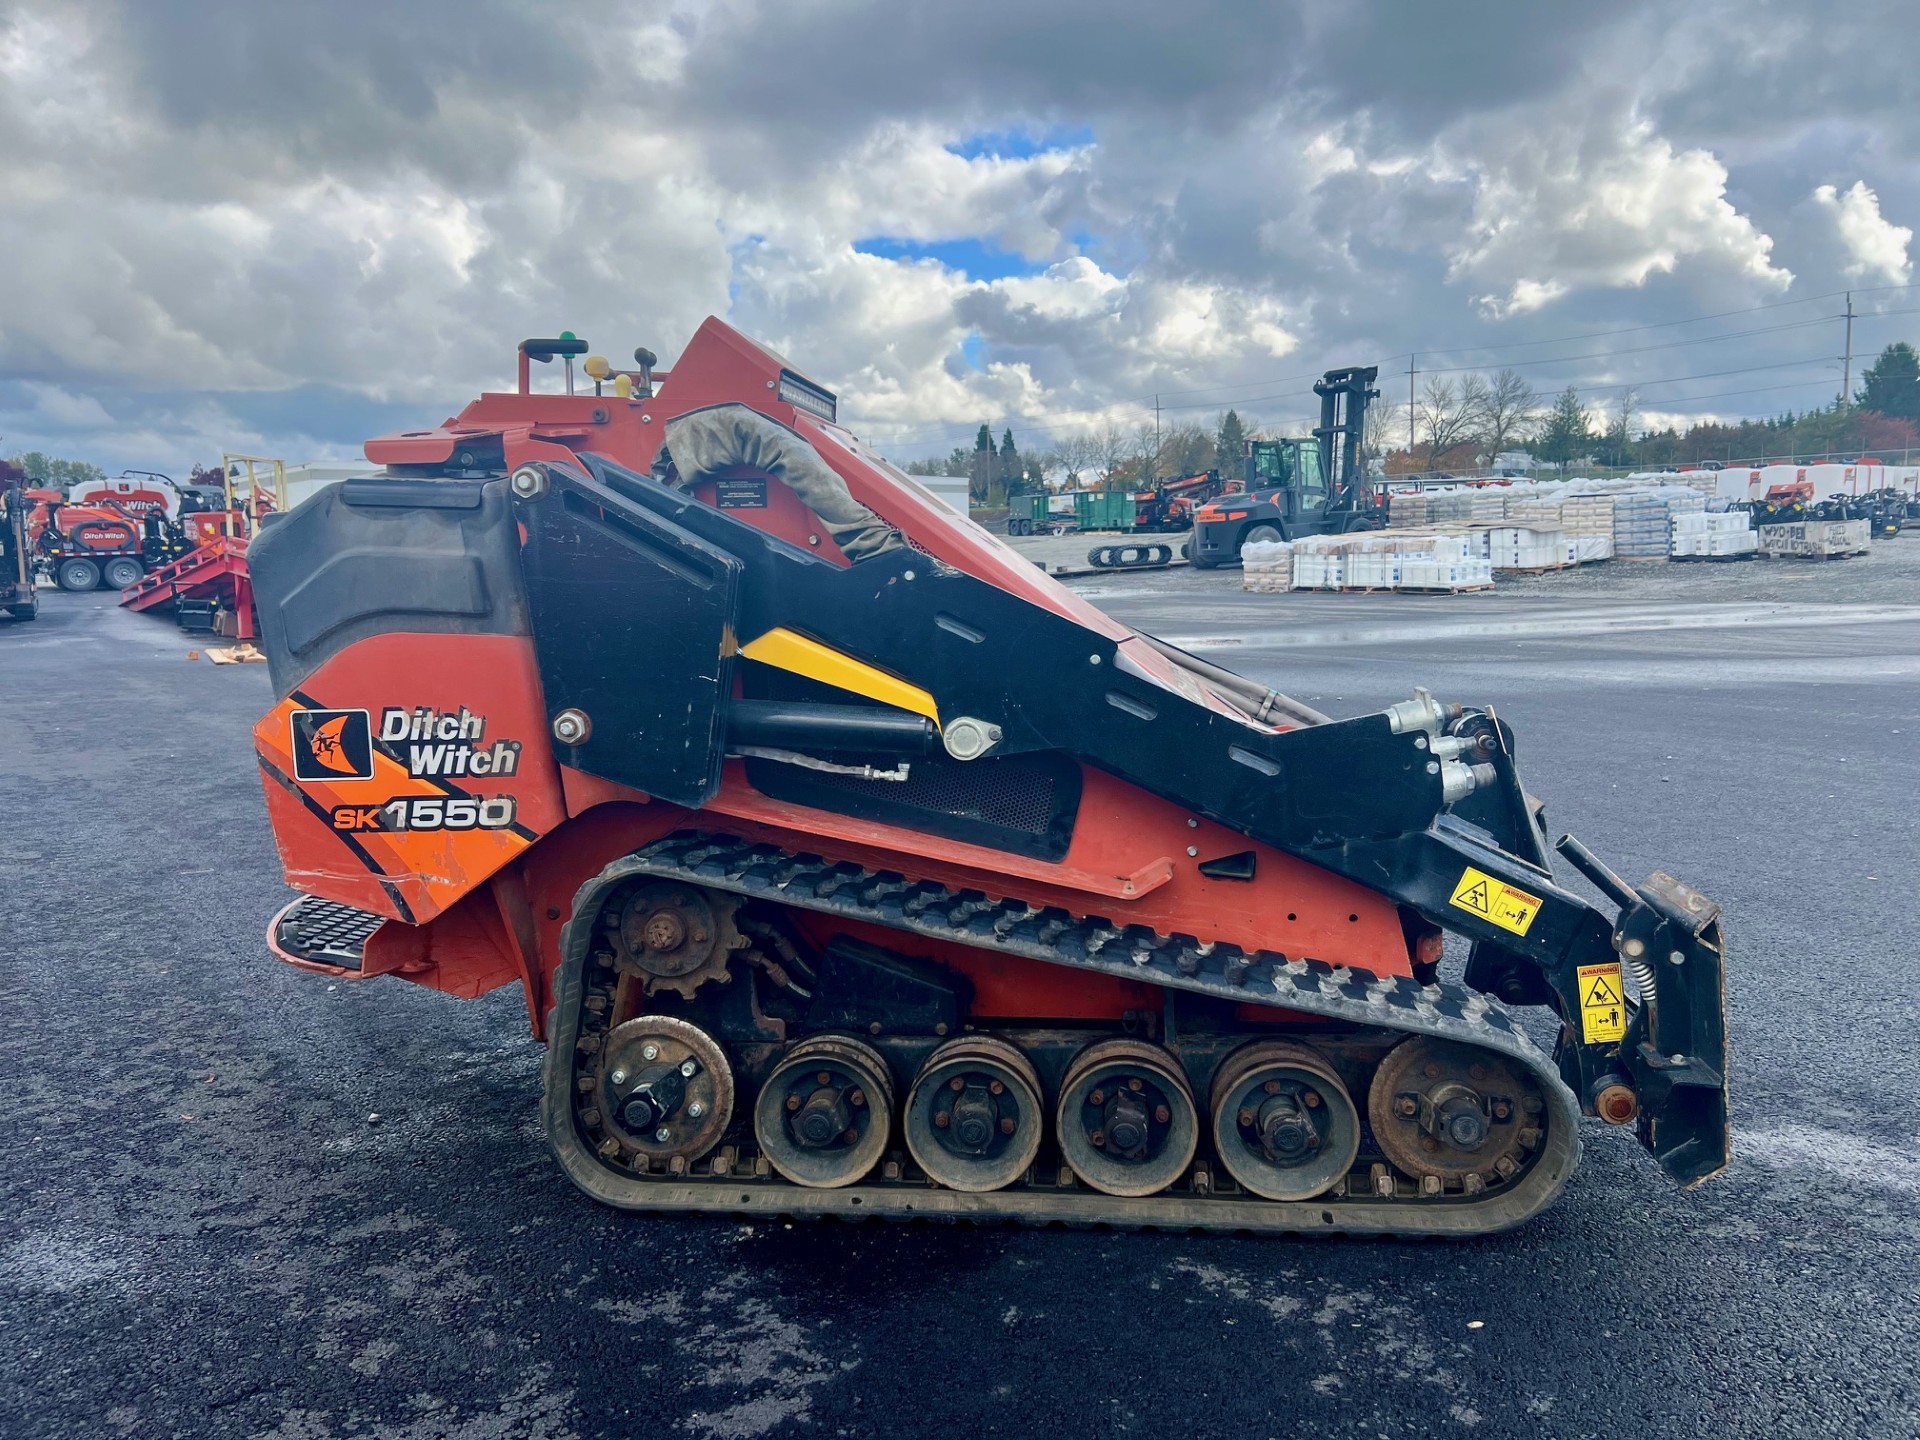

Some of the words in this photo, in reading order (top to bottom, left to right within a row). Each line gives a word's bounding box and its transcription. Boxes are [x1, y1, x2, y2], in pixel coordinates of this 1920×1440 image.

[84, 532, 104, 540] Ditch
[104, 532, 125, 540] Witch
[381, 708, 483, 741] Ditch
[1586, 966, 1618, 975] WARNING
